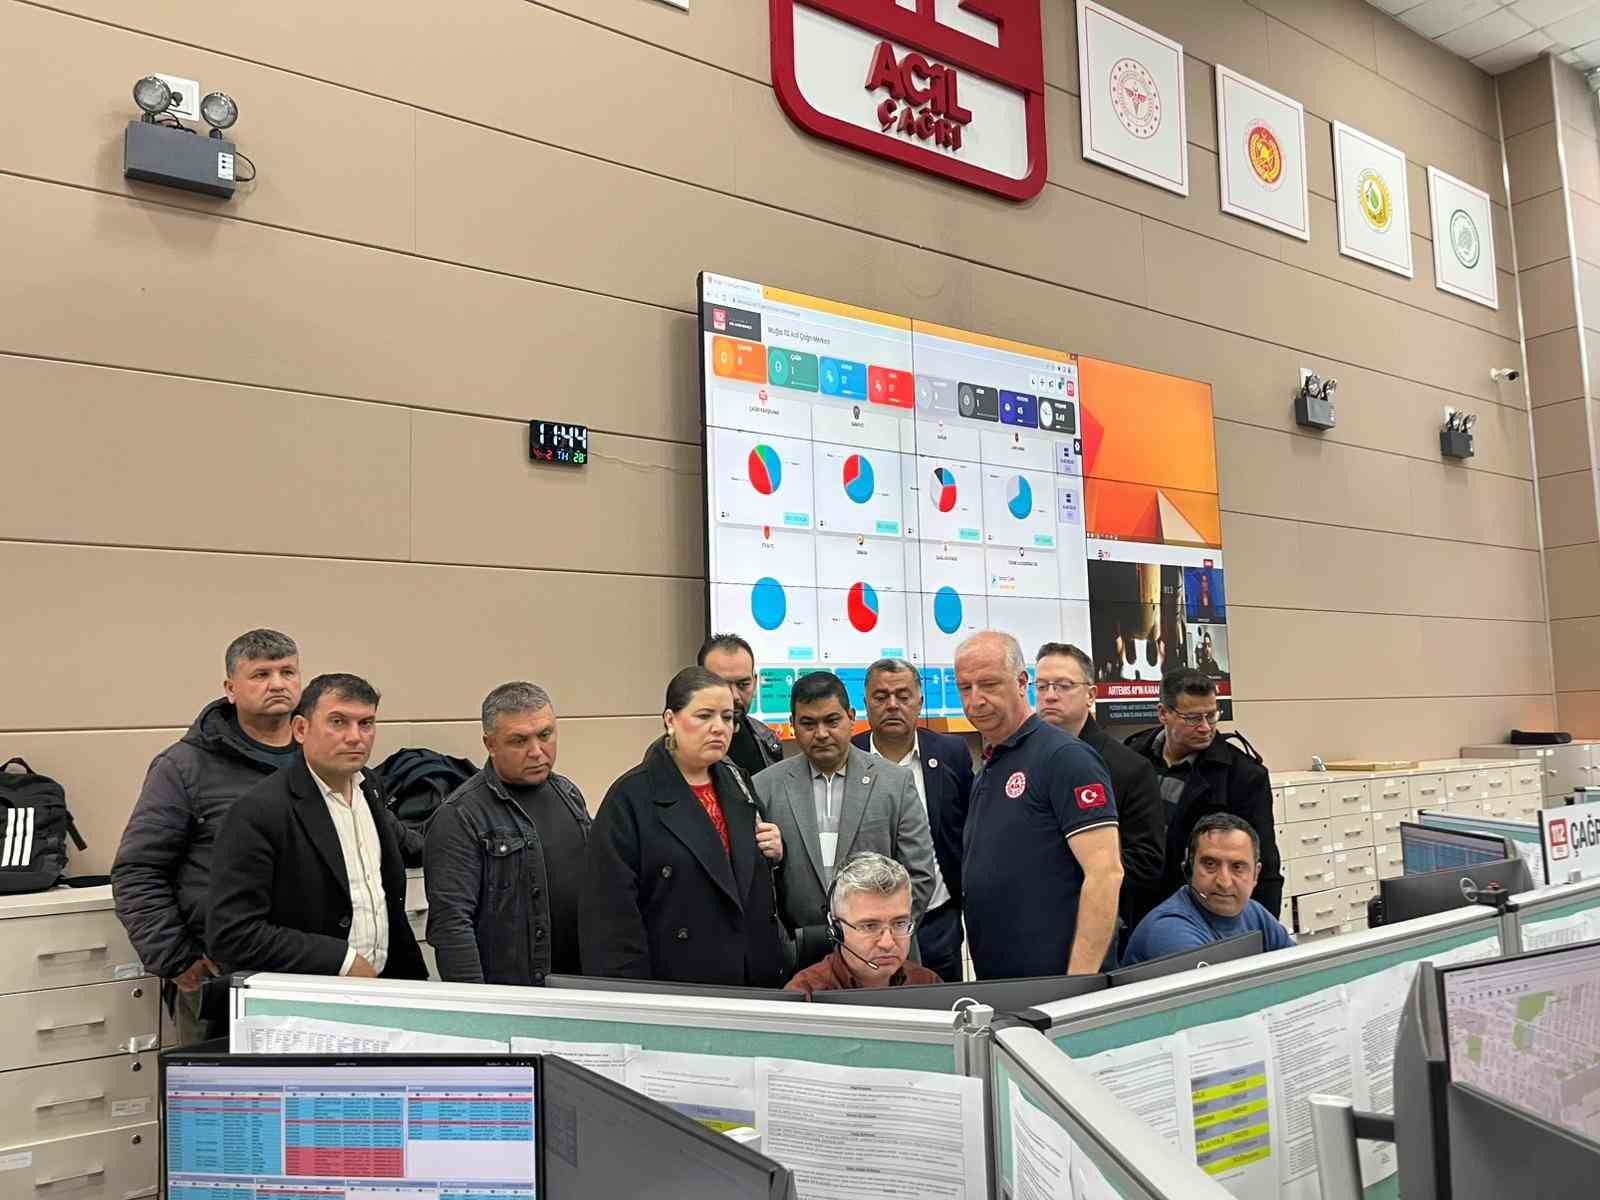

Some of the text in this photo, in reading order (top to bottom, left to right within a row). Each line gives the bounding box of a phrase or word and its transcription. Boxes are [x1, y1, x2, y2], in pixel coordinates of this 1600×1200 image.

[865, 41, 972, 125] ACİL
[877, 99, 962, 151] ÇAĞRI
[540, 423, 587, 450] 11:44
[573, 452, 585, 463] 28
[1551, 823, 1566, 843] 112
